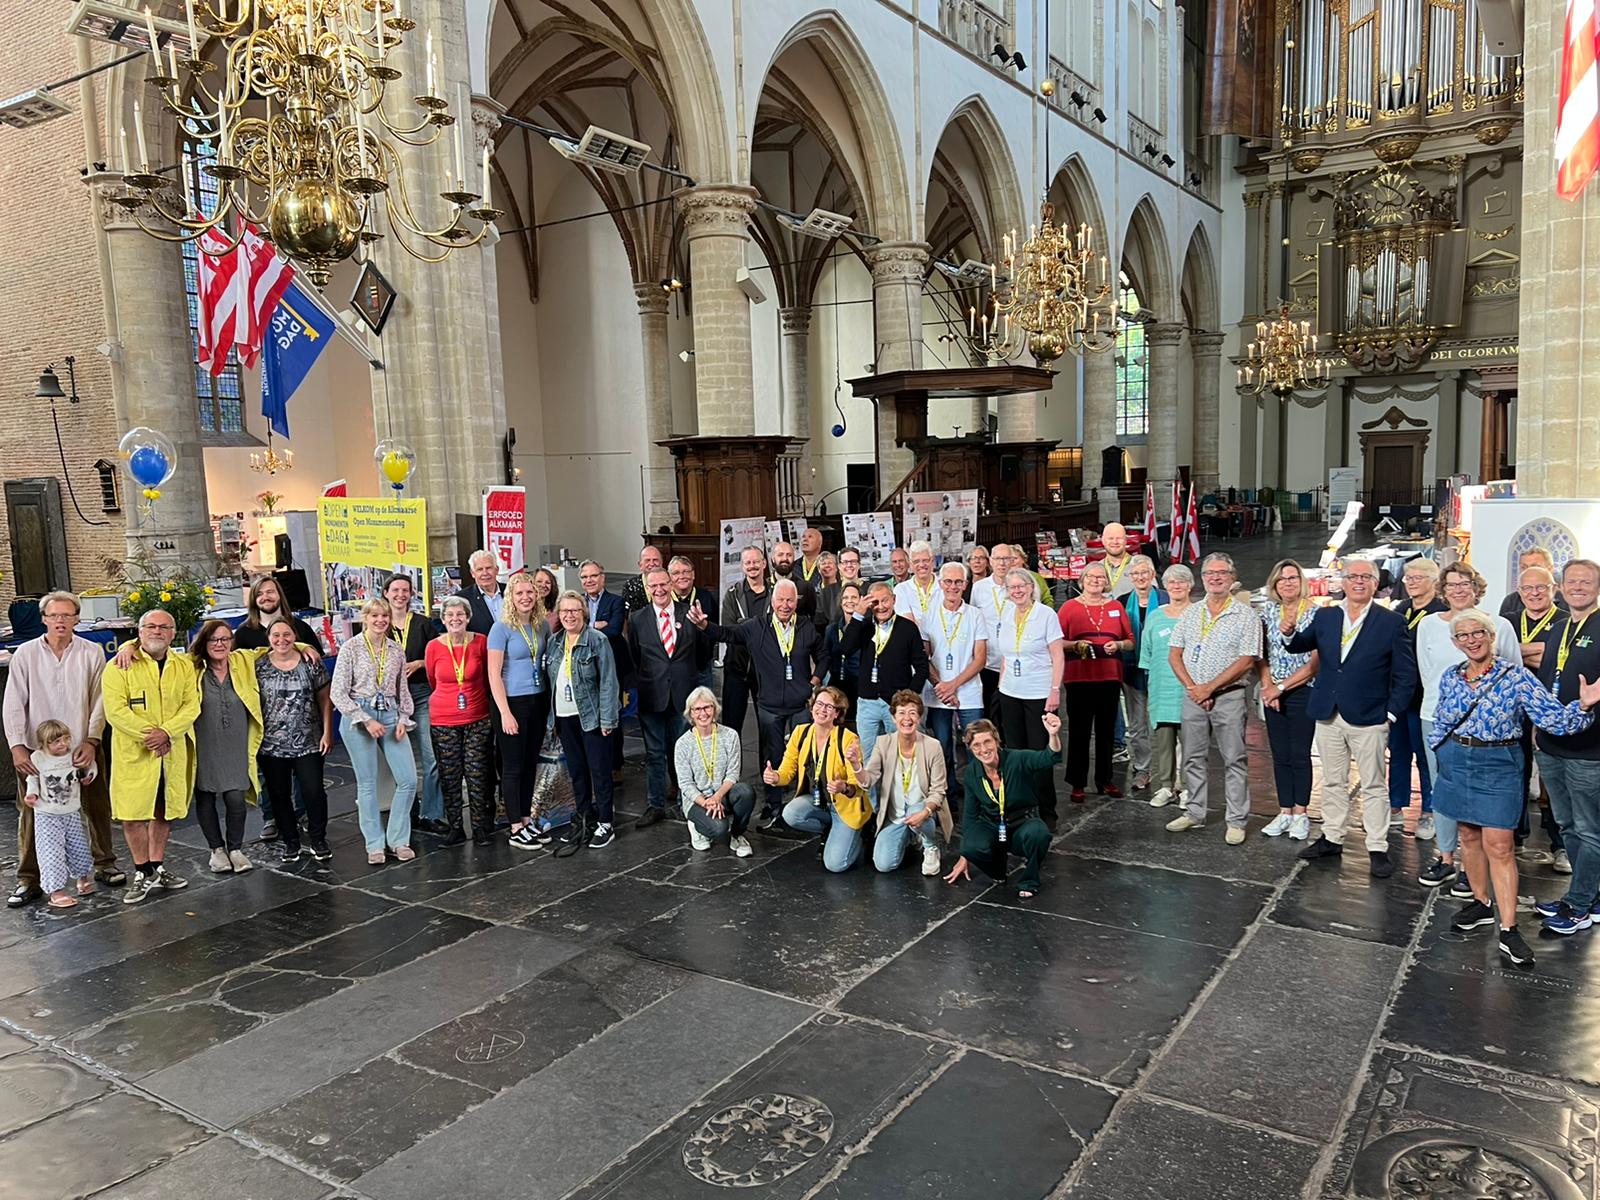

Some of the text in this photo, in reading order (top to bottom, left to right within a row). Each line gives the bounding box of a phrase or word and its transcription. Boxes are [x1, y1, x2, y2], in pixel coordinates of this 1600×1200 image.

[1430, 345, 1519, 360] DEI GLORIAM
[352, 504, 375, 513] WELKOM
[488, 510, 523, 519] ERFGOED
[353, 517, 365, 527] Open
[488, 520, 523, 529] ALKMAAR
[330, 529, 345, 544] DAG
